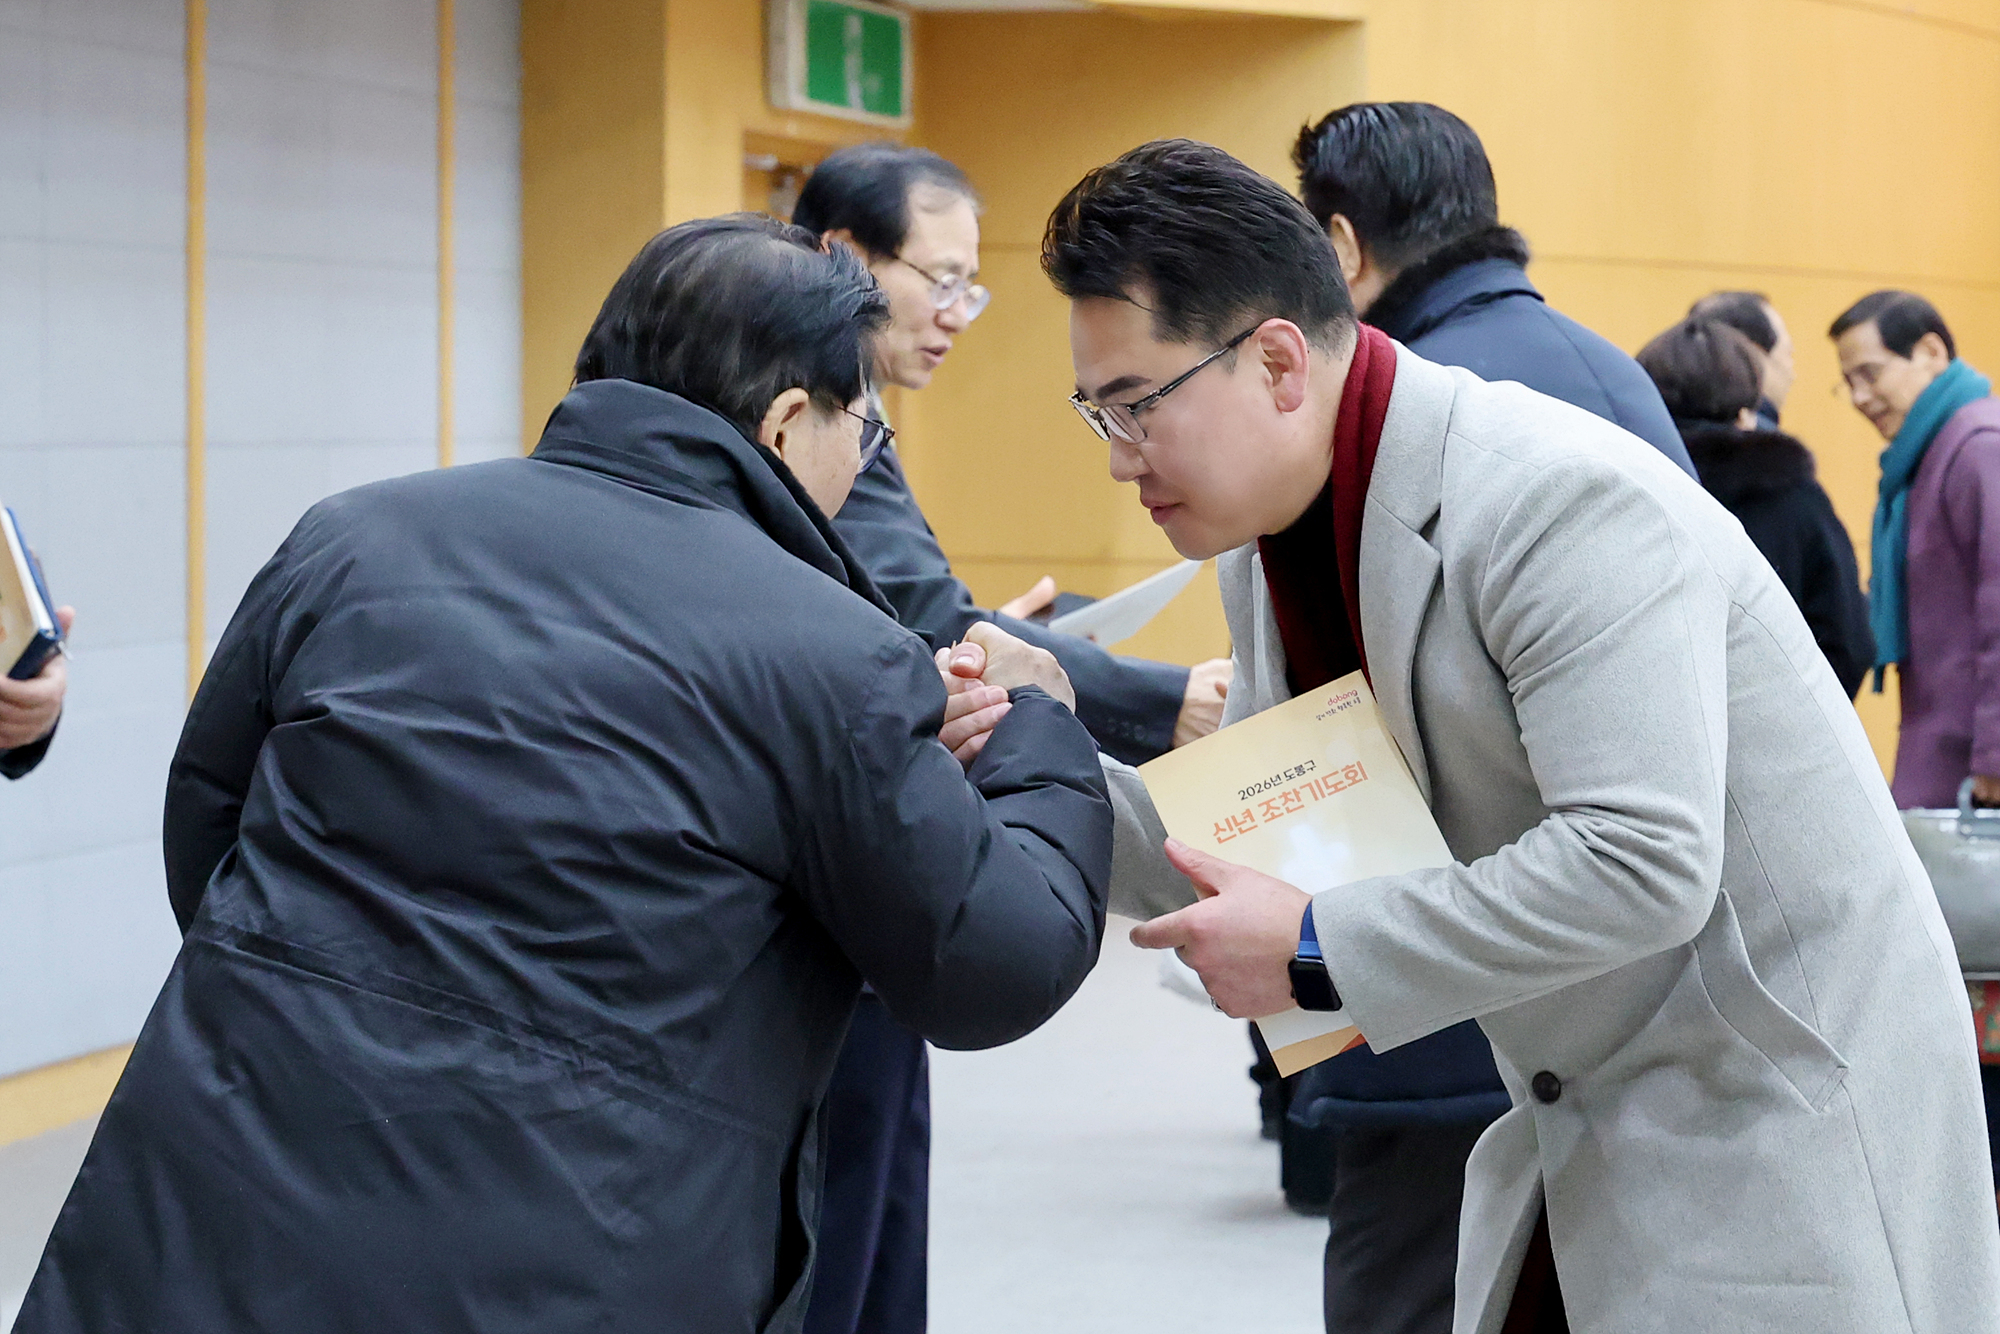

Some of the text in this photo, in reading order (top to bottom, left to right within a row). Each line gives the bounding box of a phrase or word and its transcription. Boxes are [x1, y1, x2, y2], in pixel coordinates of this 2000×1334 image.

[1328, 690, 1358, 706] dobong
[1238, 774, 1283, 801] 2026년
[1213, 760, 1369, 844] 신년 조찬기도회
